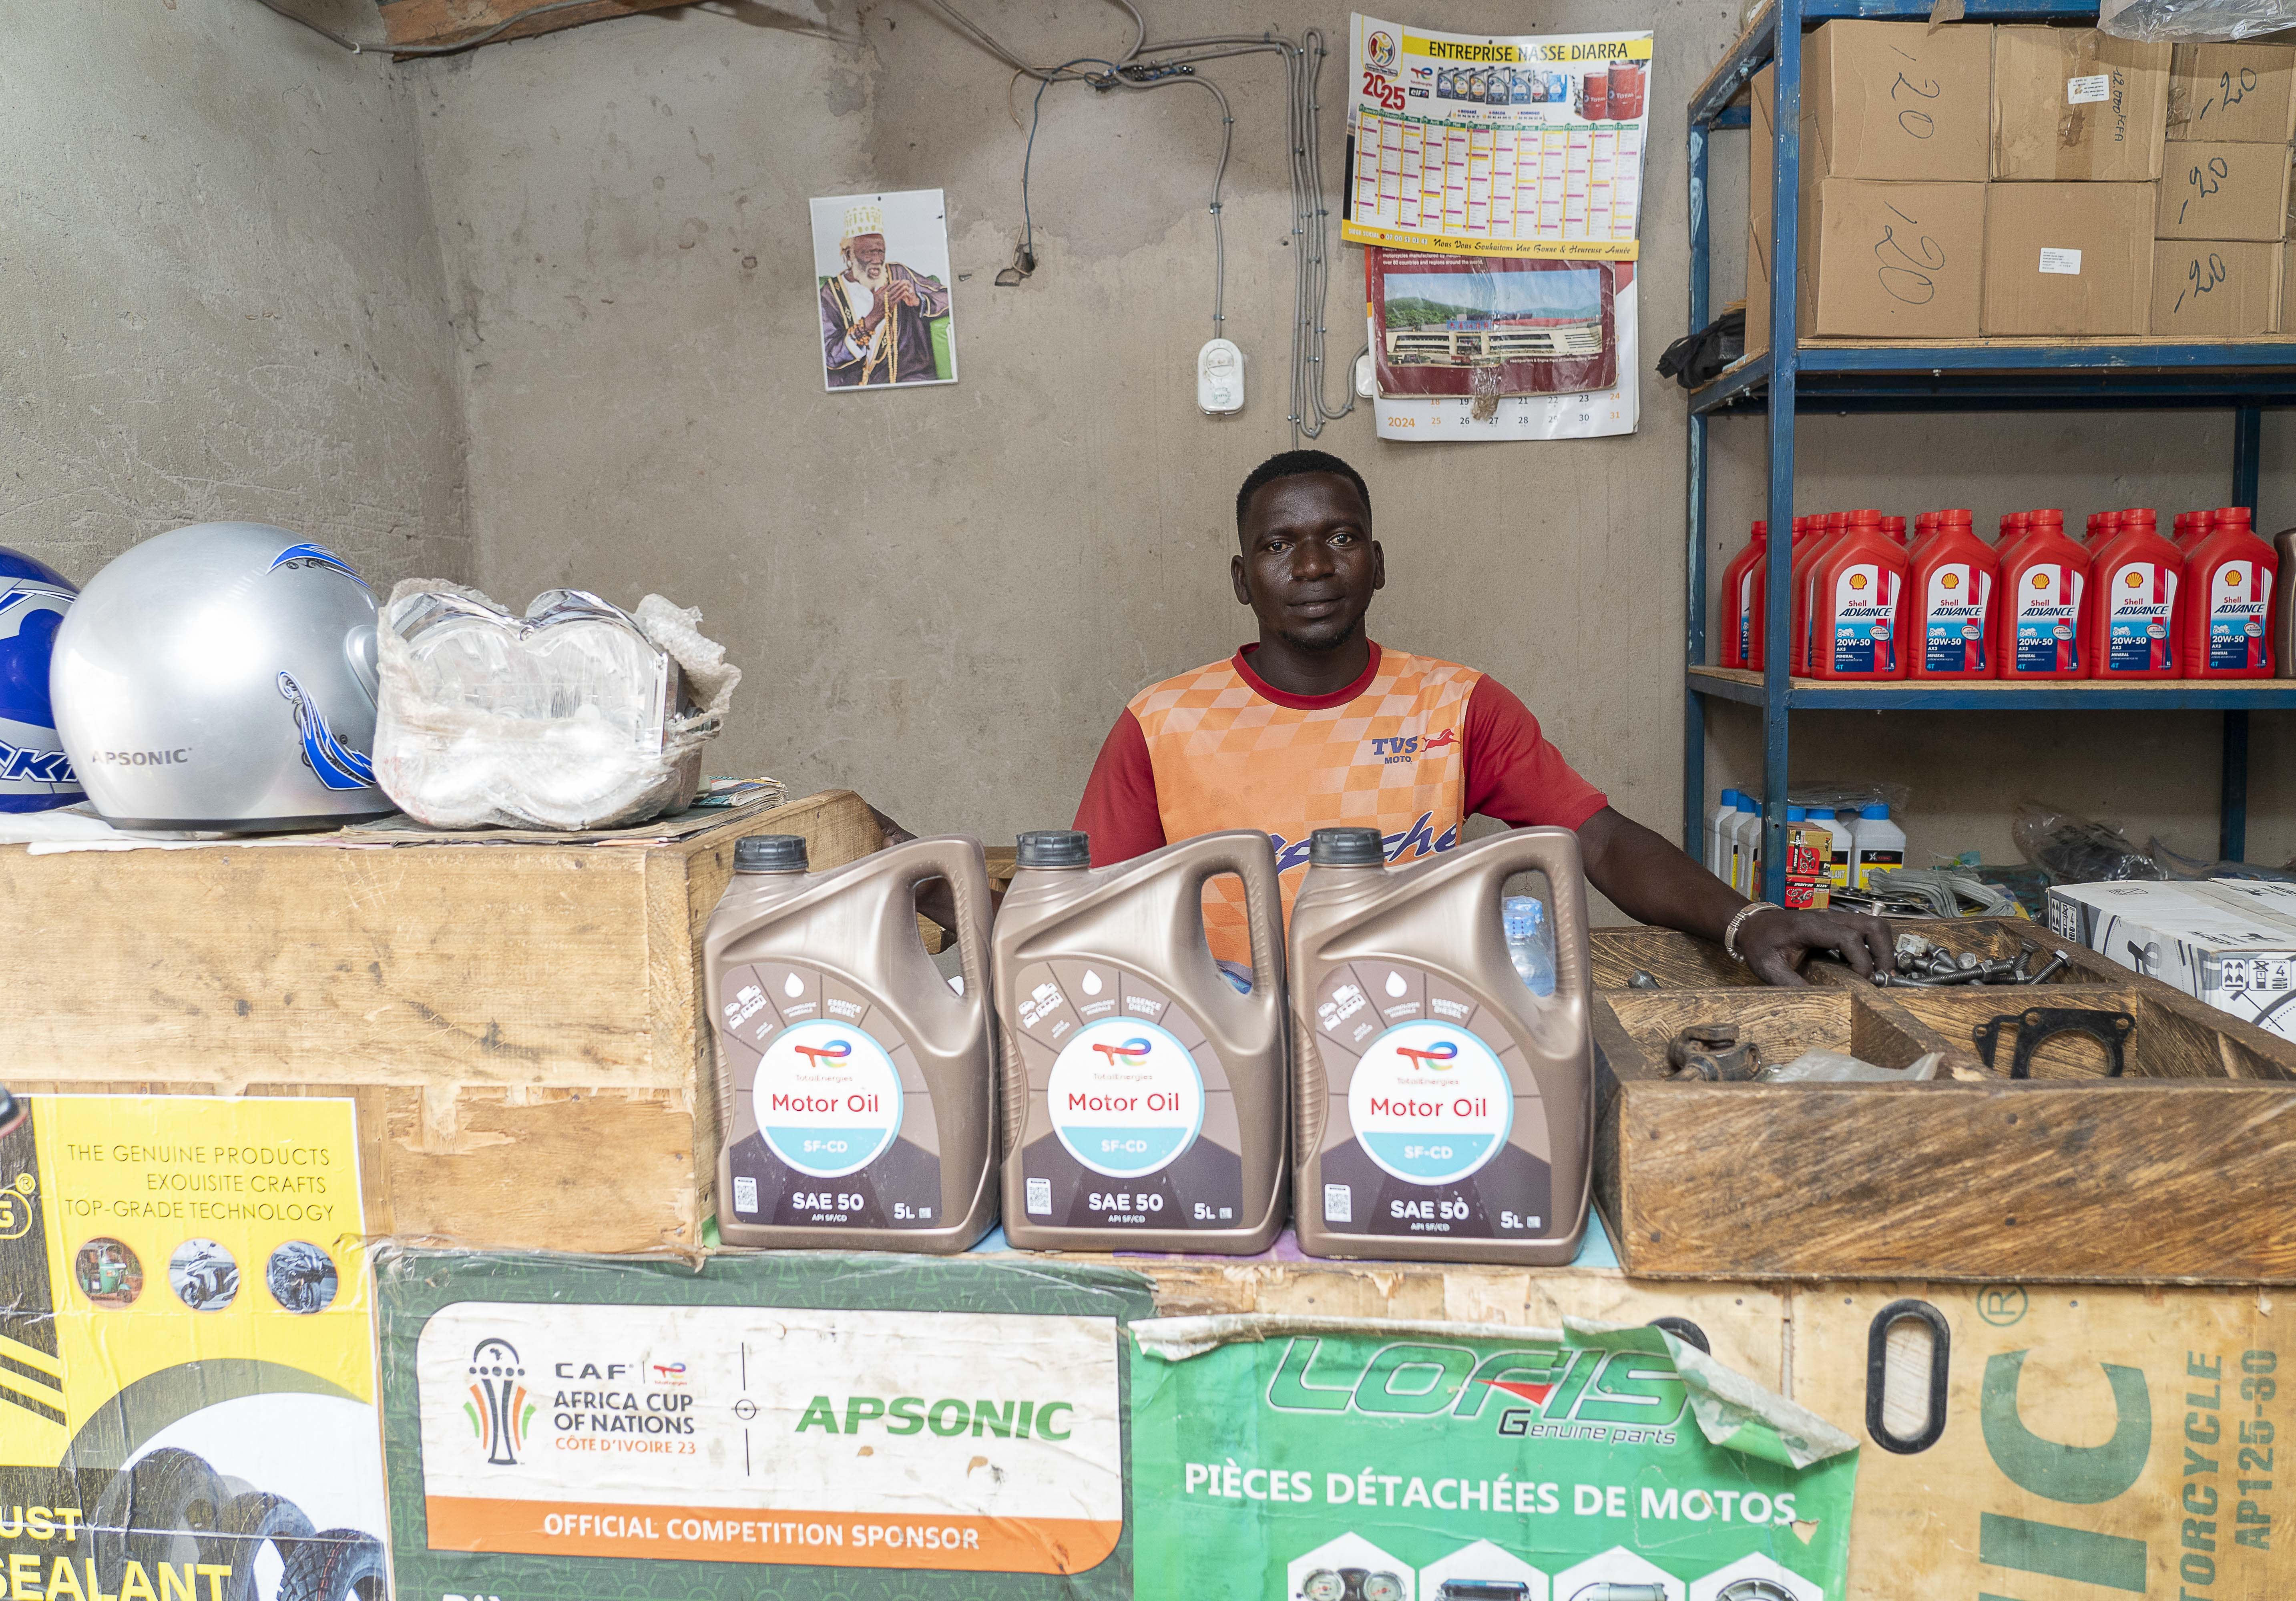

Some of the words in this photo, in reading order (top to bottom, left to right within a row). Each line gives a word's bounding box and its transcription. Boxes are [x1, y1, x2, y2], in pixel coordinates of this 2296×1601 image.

[1429, 41, 1512, 61] ENTREPRISE
[1518, 45, 1565, 61] NASSE
[1572, 43, 1627, 59] DIARRA
[1363, 72, 1405, 110] 2025
[1411, 88, 1422, 96] elf
[1434, 239, 1451, 248] Nous
[1454, 240, 1472, 249] Vous
[1474, 241, 1513, 251] Souhaitons
[1516, 244, 1531, 252] Une
[1560, 245, 1566, 253] &
[1569, 245, 1602, 254] Heureuse
[1605, 246, 1631, 254] Année
[1388, 417, 1415, 428] 2024
[1579, 414, 1589, 422] 30
[1610, 411, 1620, 419] 31
[1838, 608, 1892, 616] ADVANCE
[1930, 607, 1983, 616] ADVANCE
[2021, 607, 2075, 616] ADVANCE
[2114, 606, 2169, 615] ADVANCE
[2214, 604, 2265, 613] ADVANCE
[1372, 736, 1418, 755] TVS
[92, 748, 189, 766] APSONIC
[1384, 755, 1412, 764] MOTO
[2276, 965, 2285, 977] 4
[827, 998, 862, 1013] ESSENCE
[829, 1005, 856, 1018] DIESEL
[1126, 995, 1161, 1011] ESSENCE
[1128, 1003, 1155, 1016] DIESEL
[1431, 998, 1470, 1014] ESSENCE
[1434, 1006, 1462, 1019] DIESEL
[773, 1093, 838, 1113] Motor
[848, 1094, 878, 1113] Oil
[1069, 1093, 1137, 1111] Motor
[1147, 1092, 1179, 1111] Oil
[1371, 1097, 1443, 1117] Motor
[1453, 1098, 1486, 1117] Oil
[804, 1140, 848, 1153] SF-CD
[1101, 1139, 1147, 1153] SF-CD
[1404, 1146, 1453, 1159] SF-CD
[68, 1145, 104, 1161] THE
[113, 1145, 205, 1163] GENUINE
[215, 1147, 329, 1166] PRODUCTS
[251, 1176, 325, 1193] CRAFTS
[792, 1192, 833, 1210] SAE
[838, 1192, 864, 1211] 50
[1088, 1192, 1131, 1211] SAE
[1136, 1193, 1163, 1212] 50
[1390, 1200, 1435, 1219] SAE
[1440, 1200, 1469, 1220] 50
[65, 1199, 183, 1218] TOP-GRADE
[189, 1202, 333, 1222] TECHNOLOGY
[894, 1202, 915, 1220] 5L
[1108, 1214, 1121, 1223] API
[1122, 1214, 1146, 1224] SF/CD
[1194, 1202, 1216, 1220] 5L
[1410, 1222, 1424, 1231] API
[1425, 1222, 1450, 1232] SF/CD
[1501, 1210, 1524, 1229] 5L
[555, 1363, 625, 1380] CAF
[554, 1390, 639, 1411] AFRICA
[647, 1393, 693, 1412] CUP
[554, 1413, 585, 1431] OF
[591, 1414, 695, 1434] NATIONS
[795, 1395, 1074, 1440] APSONIC
[1497, 1408, 1606, 1440] Genuine
[1611, 1428, 1677, 1445] parts
[556, 1435, 596, 1451] CÔTE
[601, 1439, 673, 1453] D'IVOIRE
[678, 1441, 696, 1455] 23
[2234, 1349, 2277, 1551] AP125-30
[1185, 1457, 1313, 1503] PIÈCES
[1326, 1467, 1560, 1515] DÉTACHÉES
[1574, 1483, 1626, 1517] DE
[1641, 1487, 1797, 1525] MOTOS
[544, 1513, 659, 1539] OFFICIAL
[667, 1518, 844, 1546] COMPETITION
[852, 1525, 980, 1550] SPONSOR
[0, 1553, 233, 1601] EALANT
